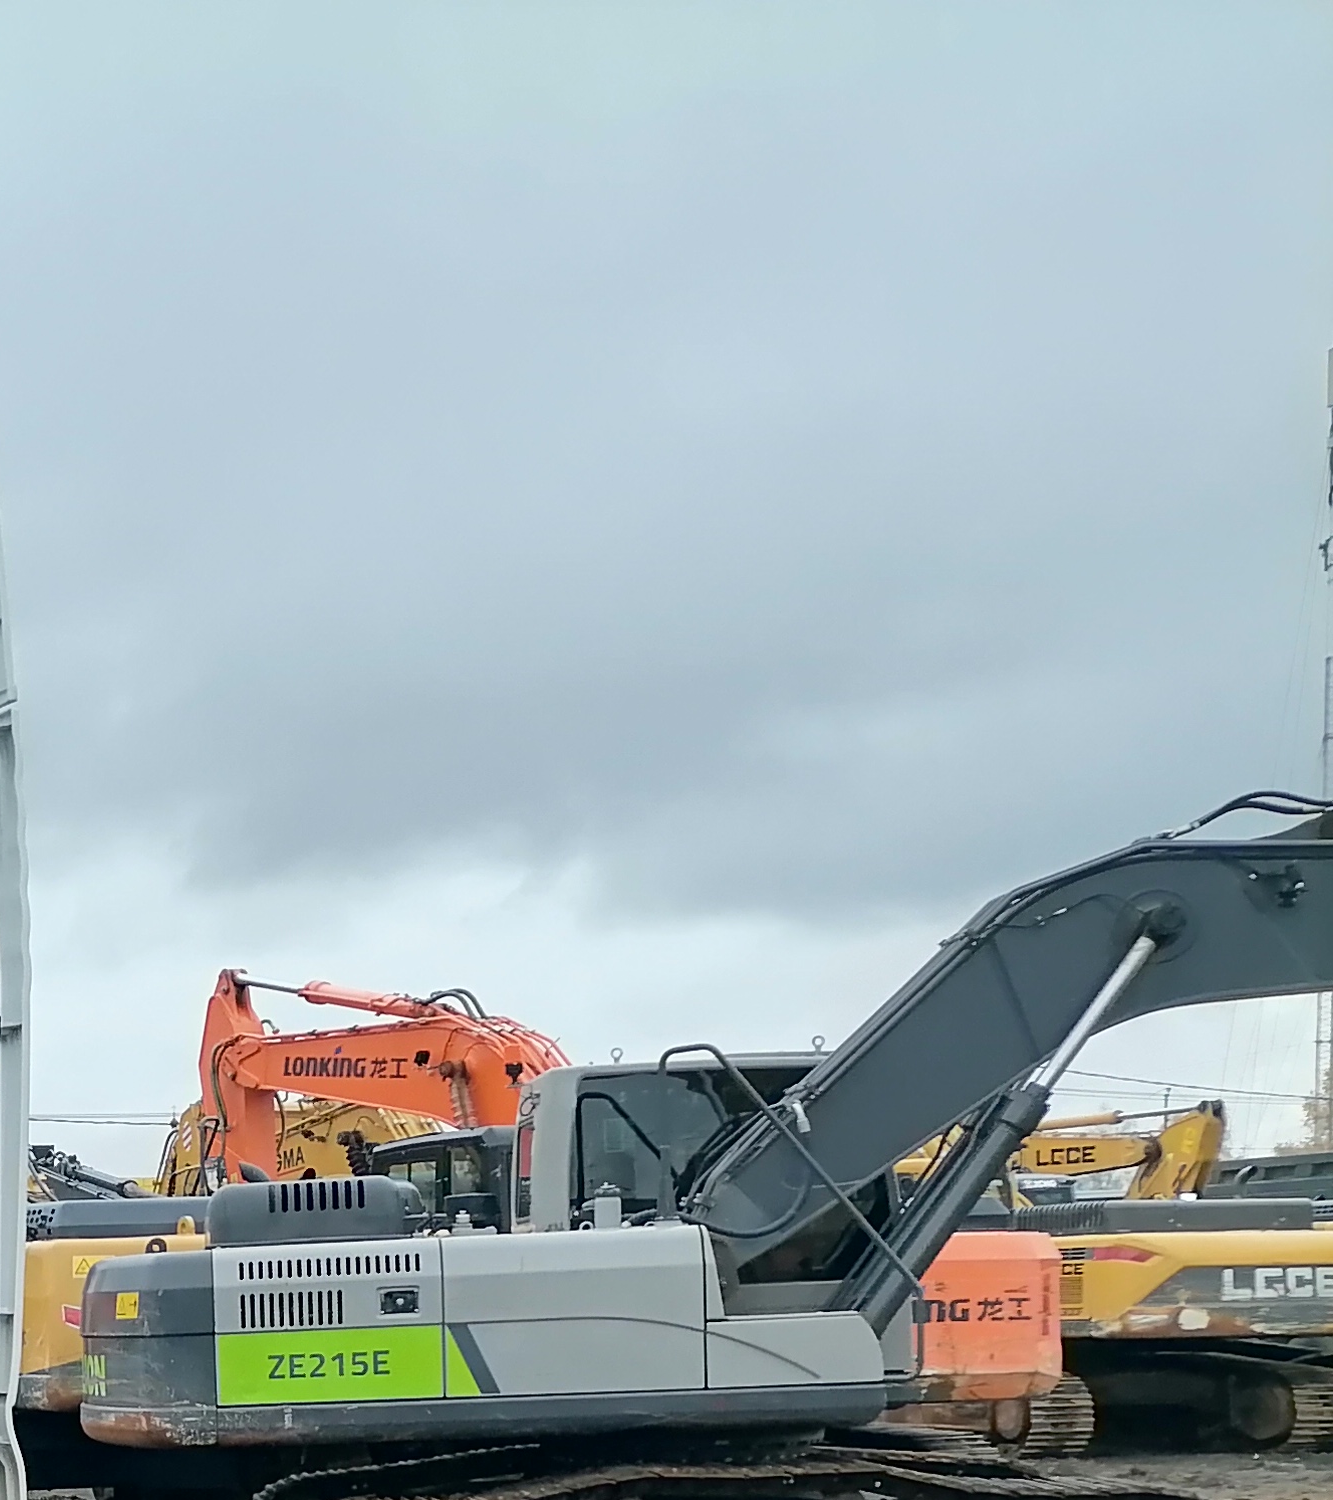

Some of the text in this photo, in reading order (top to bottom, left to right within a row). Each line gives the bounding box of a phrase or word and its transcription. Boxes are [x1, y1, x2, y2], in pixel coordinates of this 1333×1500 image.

[283, 1047, 408, 1079] LONKING 龙工
[977, 1298, 1032, 1321] 龙工
[268, 1350, 391, 1379] ZE215E
